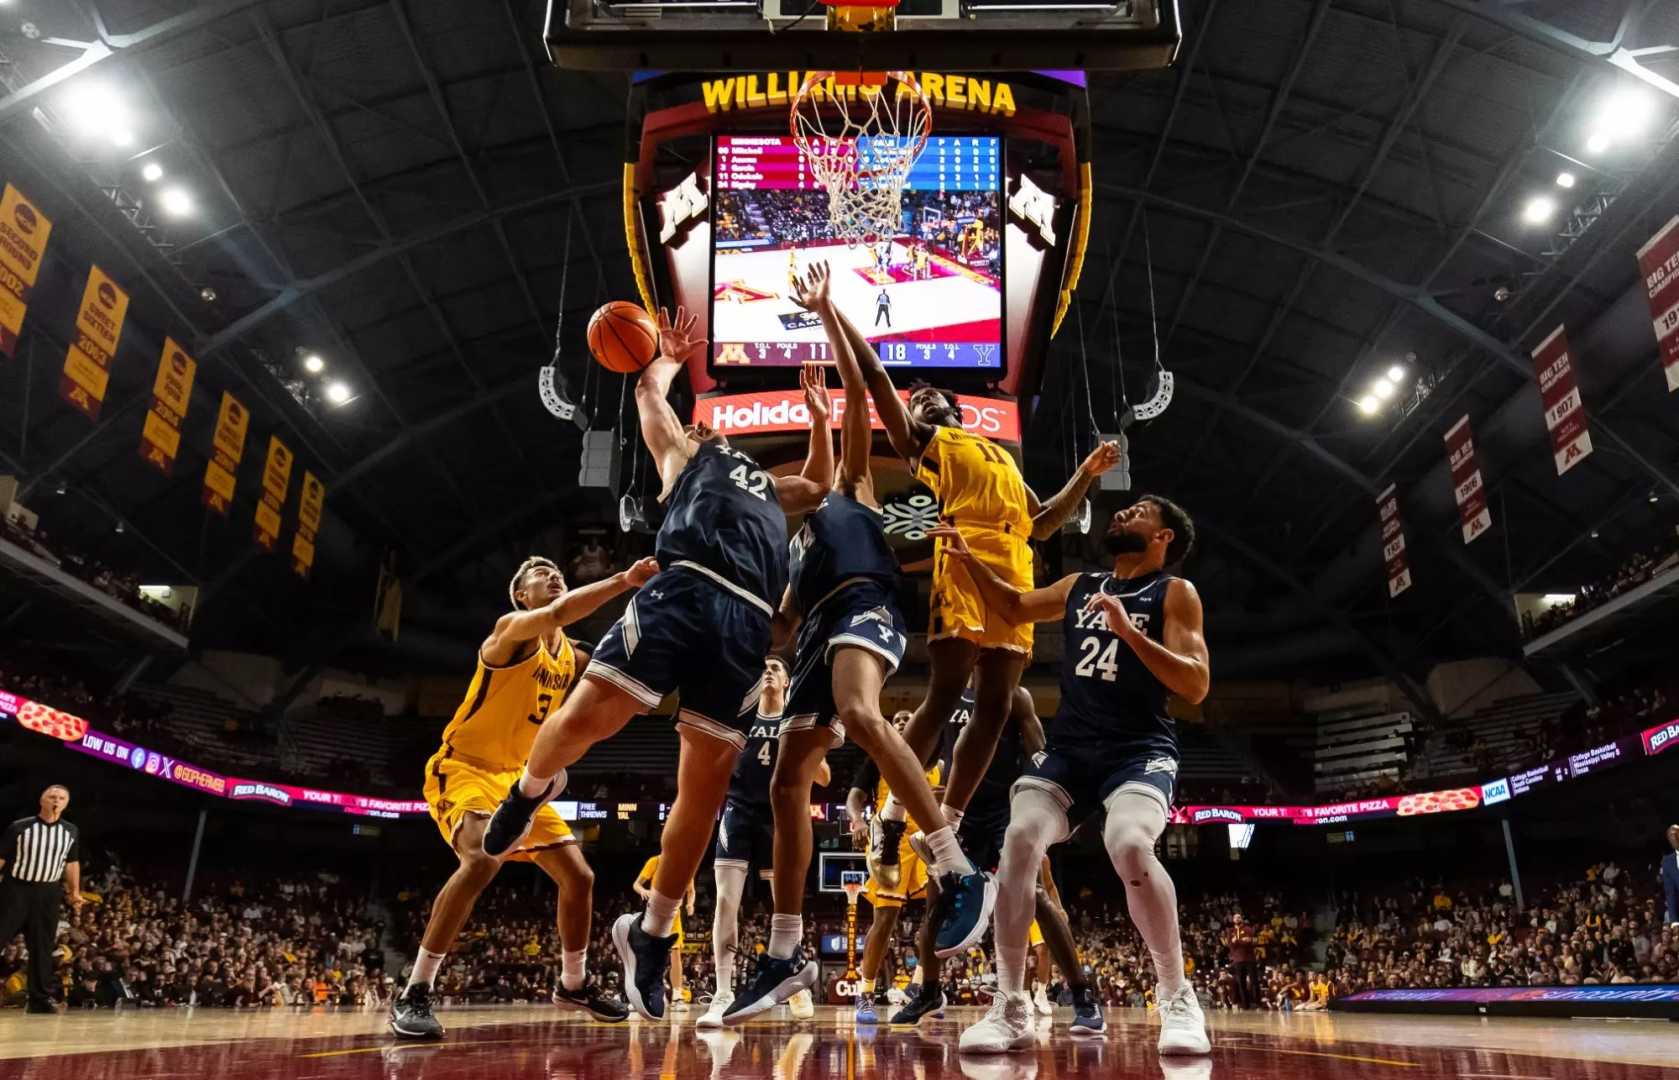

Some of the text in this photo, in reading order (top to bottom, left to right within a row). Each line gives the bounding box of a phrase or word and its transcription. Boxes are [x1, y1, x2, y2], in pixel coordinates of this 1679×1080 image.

[896, 68, 1016, 117] ARENA
[1646, 266, 1664, 290] BIG
[784, 349, 791, 359] 4
[947, 349, 955, 360] 4
[810, 343, 826, 360] 11
[887, 343, 906, 361] 18
[712, 400, 815, 429] Holida
[1551, 396, 1574, 421] 1907
[976, 442, 1008, 466] 11
[729, 464, 768, 501] 42
[1074, 608, 1150, 636] YAE
[1075, 636, 1120, 682] 24
[527, 693, 553, 725] 3
[749, 725, 780, 739] YAL
[1650, 730, 1667, 750] RED
[82, 734, 103, 751] LOW
[103, 741, 116, 756] US
[116, 746, 130, 760] ON
[757, 741, 771, 766] 4
[1572, 742, 1617, 763] College Basketball
[233, 784, 290, 803] RED BARON
[303, 789, 333, 802] YOUR
[368, 799, 413, 812] FAVORITE
[1484, 784, 1507, 799] NCAA
[1194, 808, 1242, 822] RED BARON
[1252, 807, 1278, 817] YOUR
[1314, 803, 1359, 818] FAVORITE
[1359, 799, 1390, 812] PIZZA
